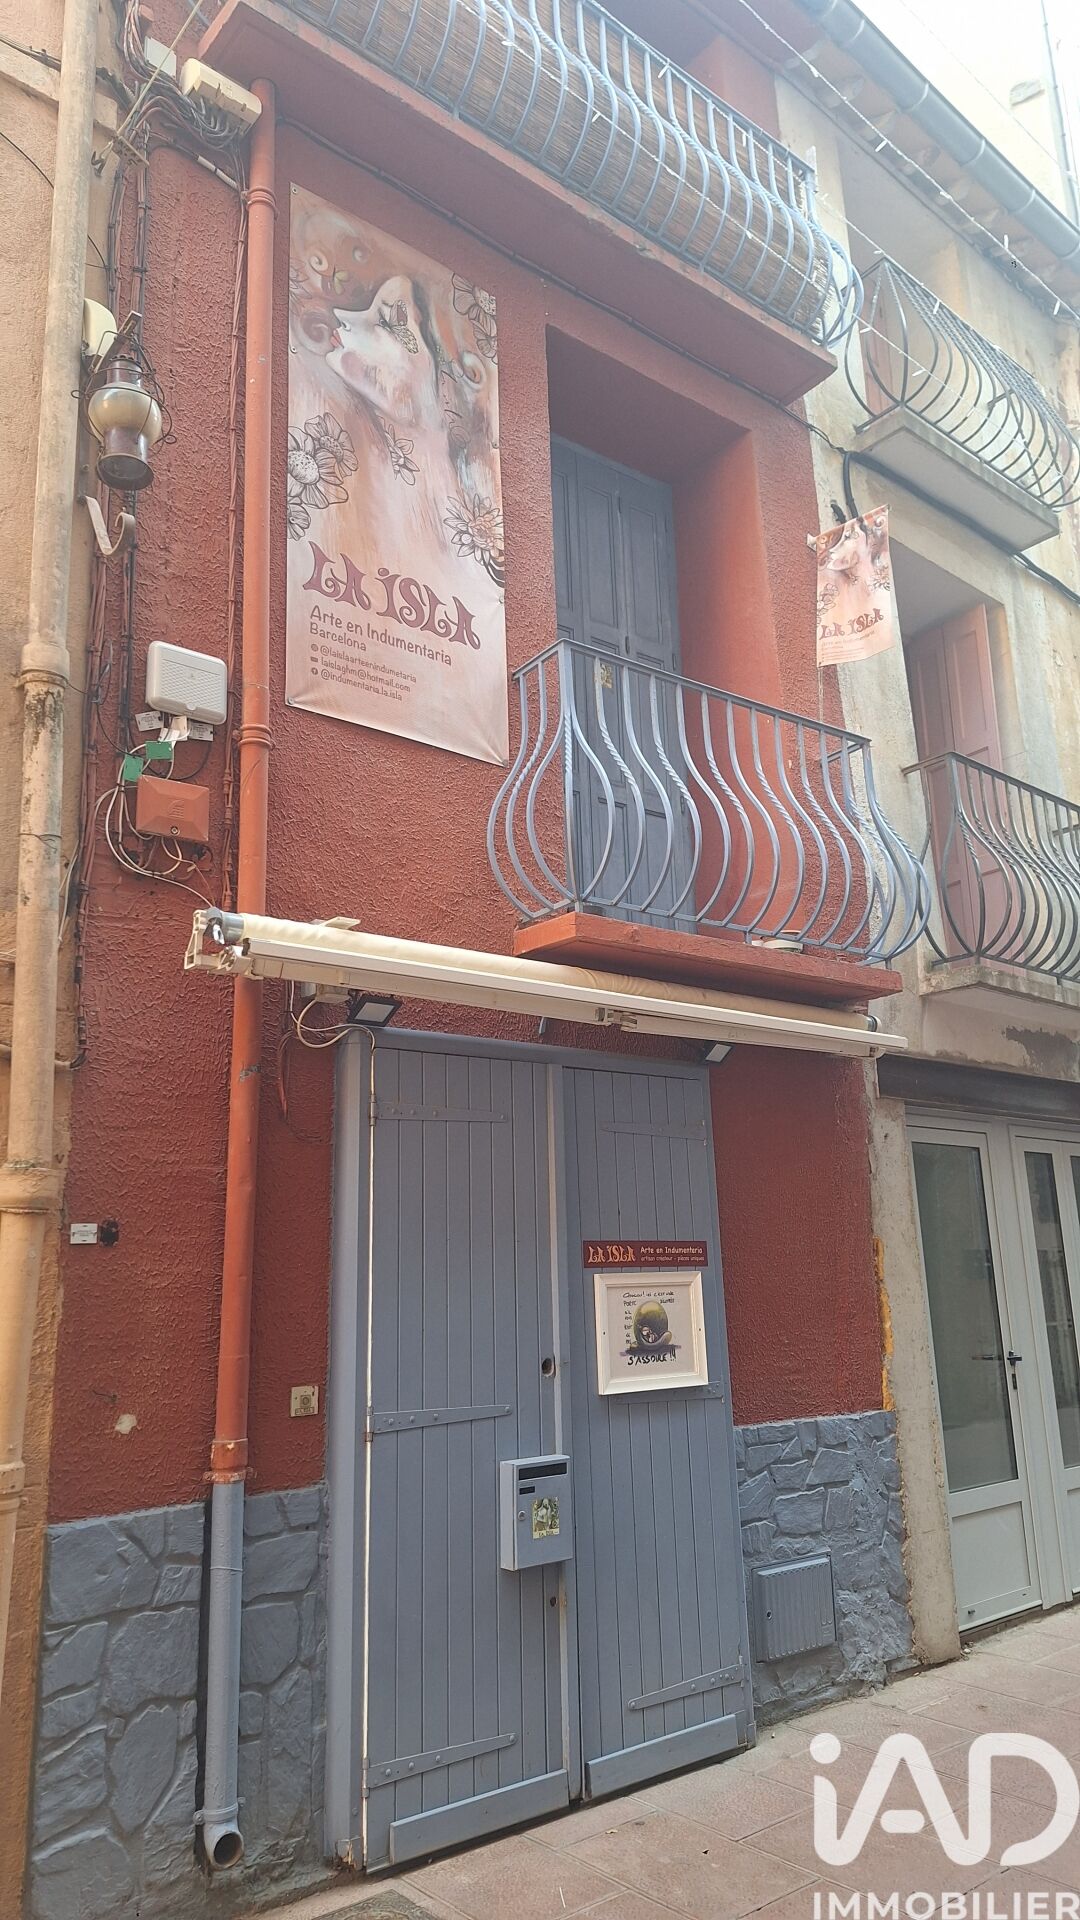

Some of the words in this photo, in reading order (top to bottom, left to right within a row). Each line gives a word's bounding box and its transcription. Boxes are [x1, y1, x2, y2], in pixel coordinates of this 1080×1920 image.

[302, 541, 371, 611] LA
[309, 622, 367, 652] Barcelona
[310, 604, 342, 629] Arte
[346, 621, 363, 636] en
[367, 623, 452, 666] Indumentaria
[819, 622, 845, 640] LA
[588, 1246, 605, 1263] LA
[640, 1246, 654, 1254] Arte
